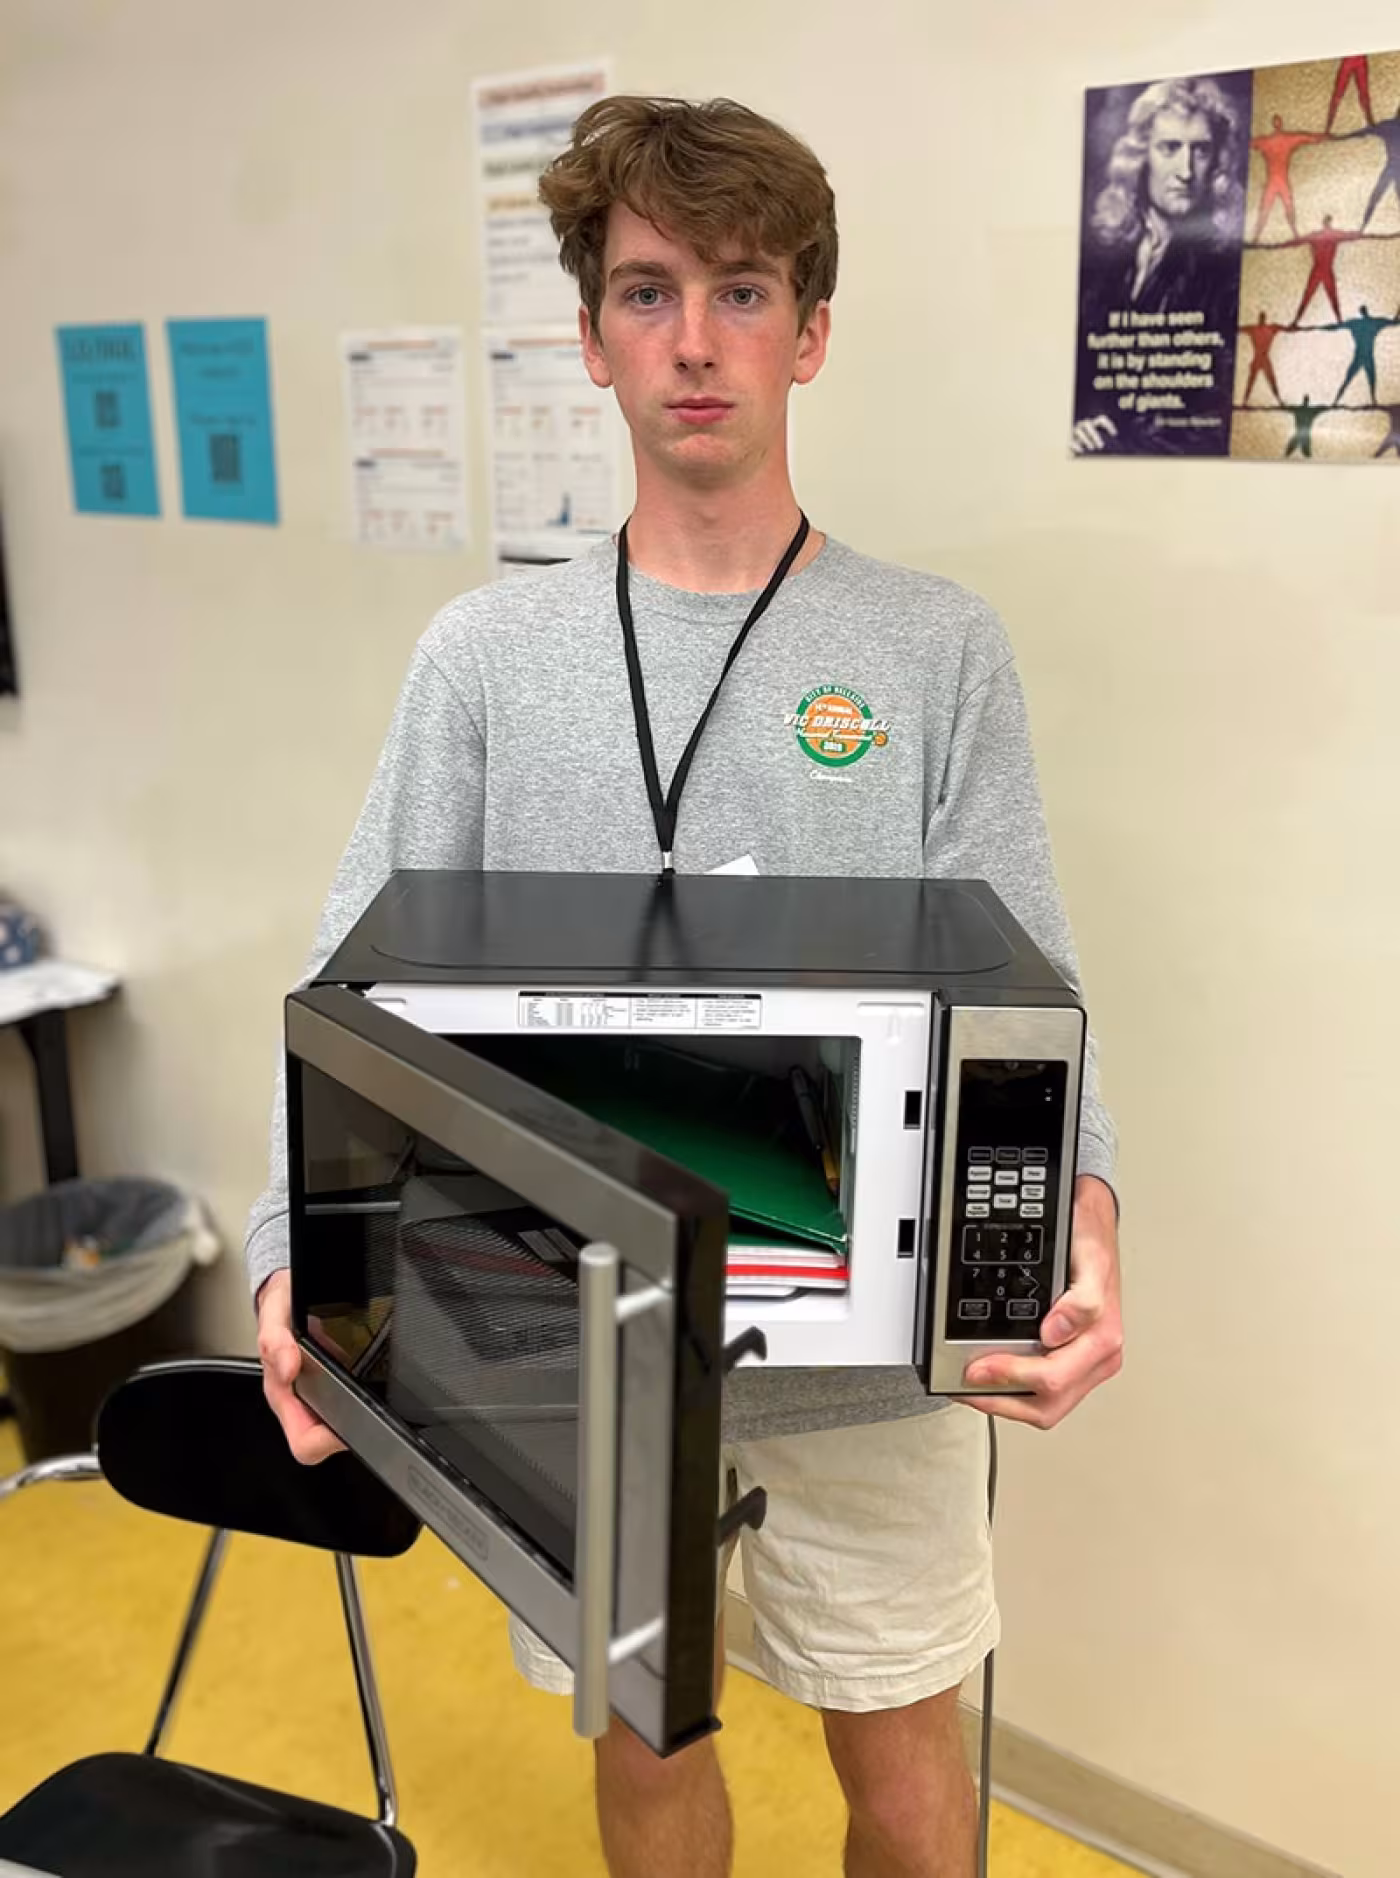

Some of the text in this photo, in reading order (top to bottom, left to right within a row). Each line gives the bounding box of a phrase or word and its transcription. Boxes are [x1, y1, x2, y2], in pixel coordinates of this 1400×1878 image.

[1130, 311, 1165, 327] have
[1168, 311, 1205, 325] seen
[1087, 333, 1135, 349] further
[1137, 332, 1170, 348] than
[1110, 352, 1124, 369] is
[1126, 353, 1145, 372] by
[1148, 351, 1212, 370] standing
[1093, 371, 1214, 390] on the shoulders
[1118, 393, 1135, 410] of
[1000, 1232, 1008, 1243] 2
[1025, 1231, 1033, 1243] 3
[973, 1249, 1032, 1260] 4 5 6
[973, 1267, 980, 1278] 7
[997, 1267, 1006, 1279] 8
[996, 1285, 1005, 1296] 0
